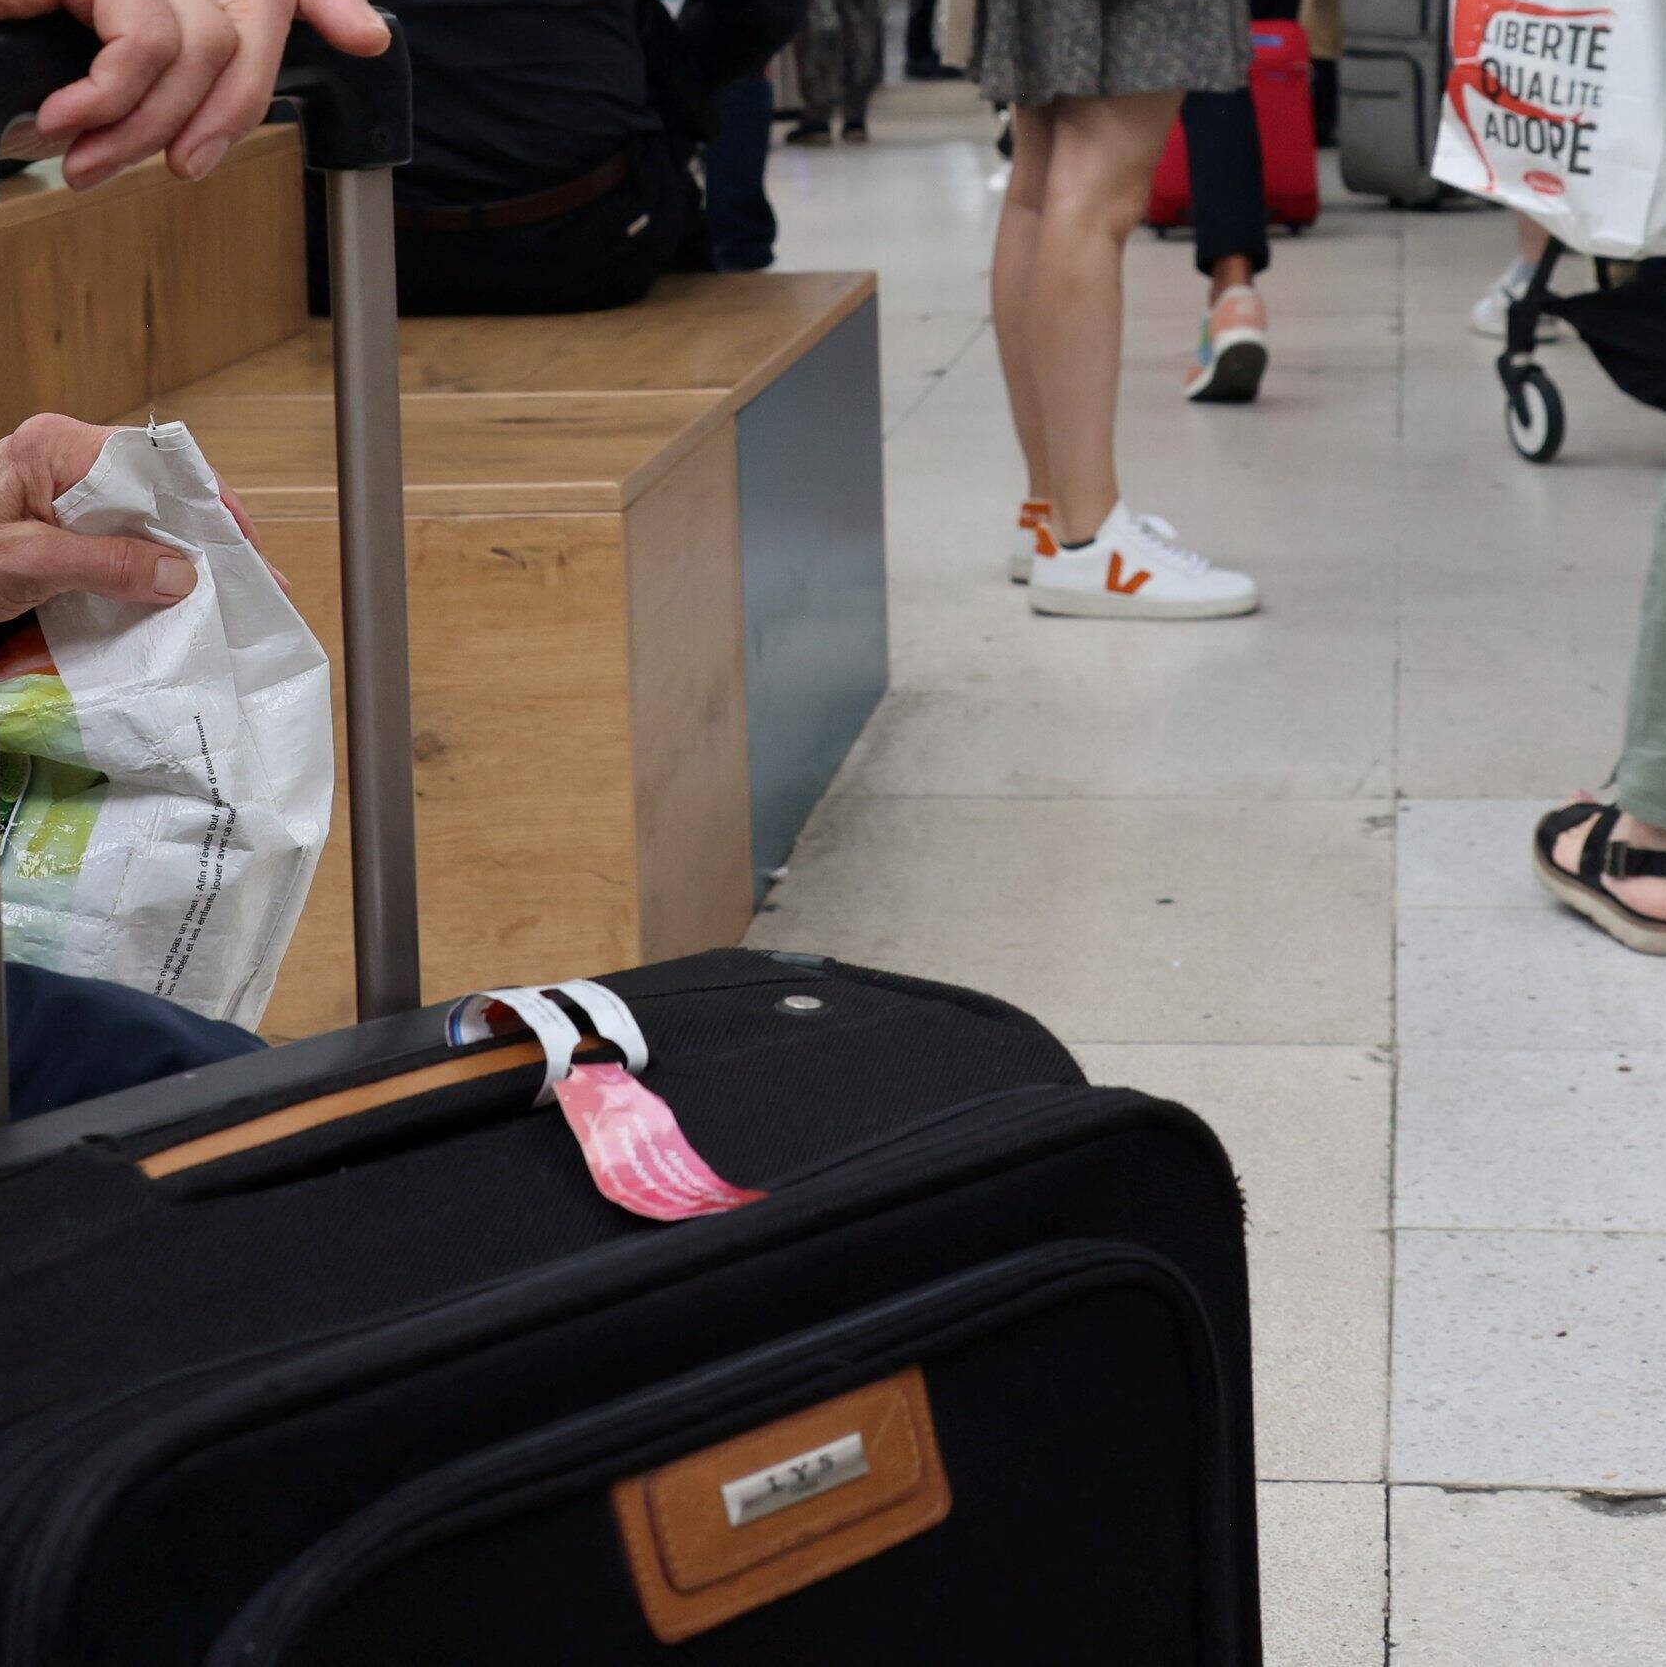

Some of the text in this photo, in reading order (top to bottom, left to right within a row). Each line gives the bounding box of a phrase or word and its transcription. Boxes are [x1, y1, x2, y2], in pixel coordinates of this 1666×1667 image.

[223, 826, 232, 836] ce
[217, 838, 229, 860] avec
[170, 937, 182, 953] pas
[179, 923, 188, 935] un
[184, 899, 199, 921] jouet
[196, 870, 207, 891] Afin
[207, 814, 219, 832] tout
[211, 863, 223, 891] jouer
[198, 892, 217, 926] enfants
[189, 928, 201, 941] les
[186, 943, 195, 952] et
[172, 954, 189, 981] bébés
